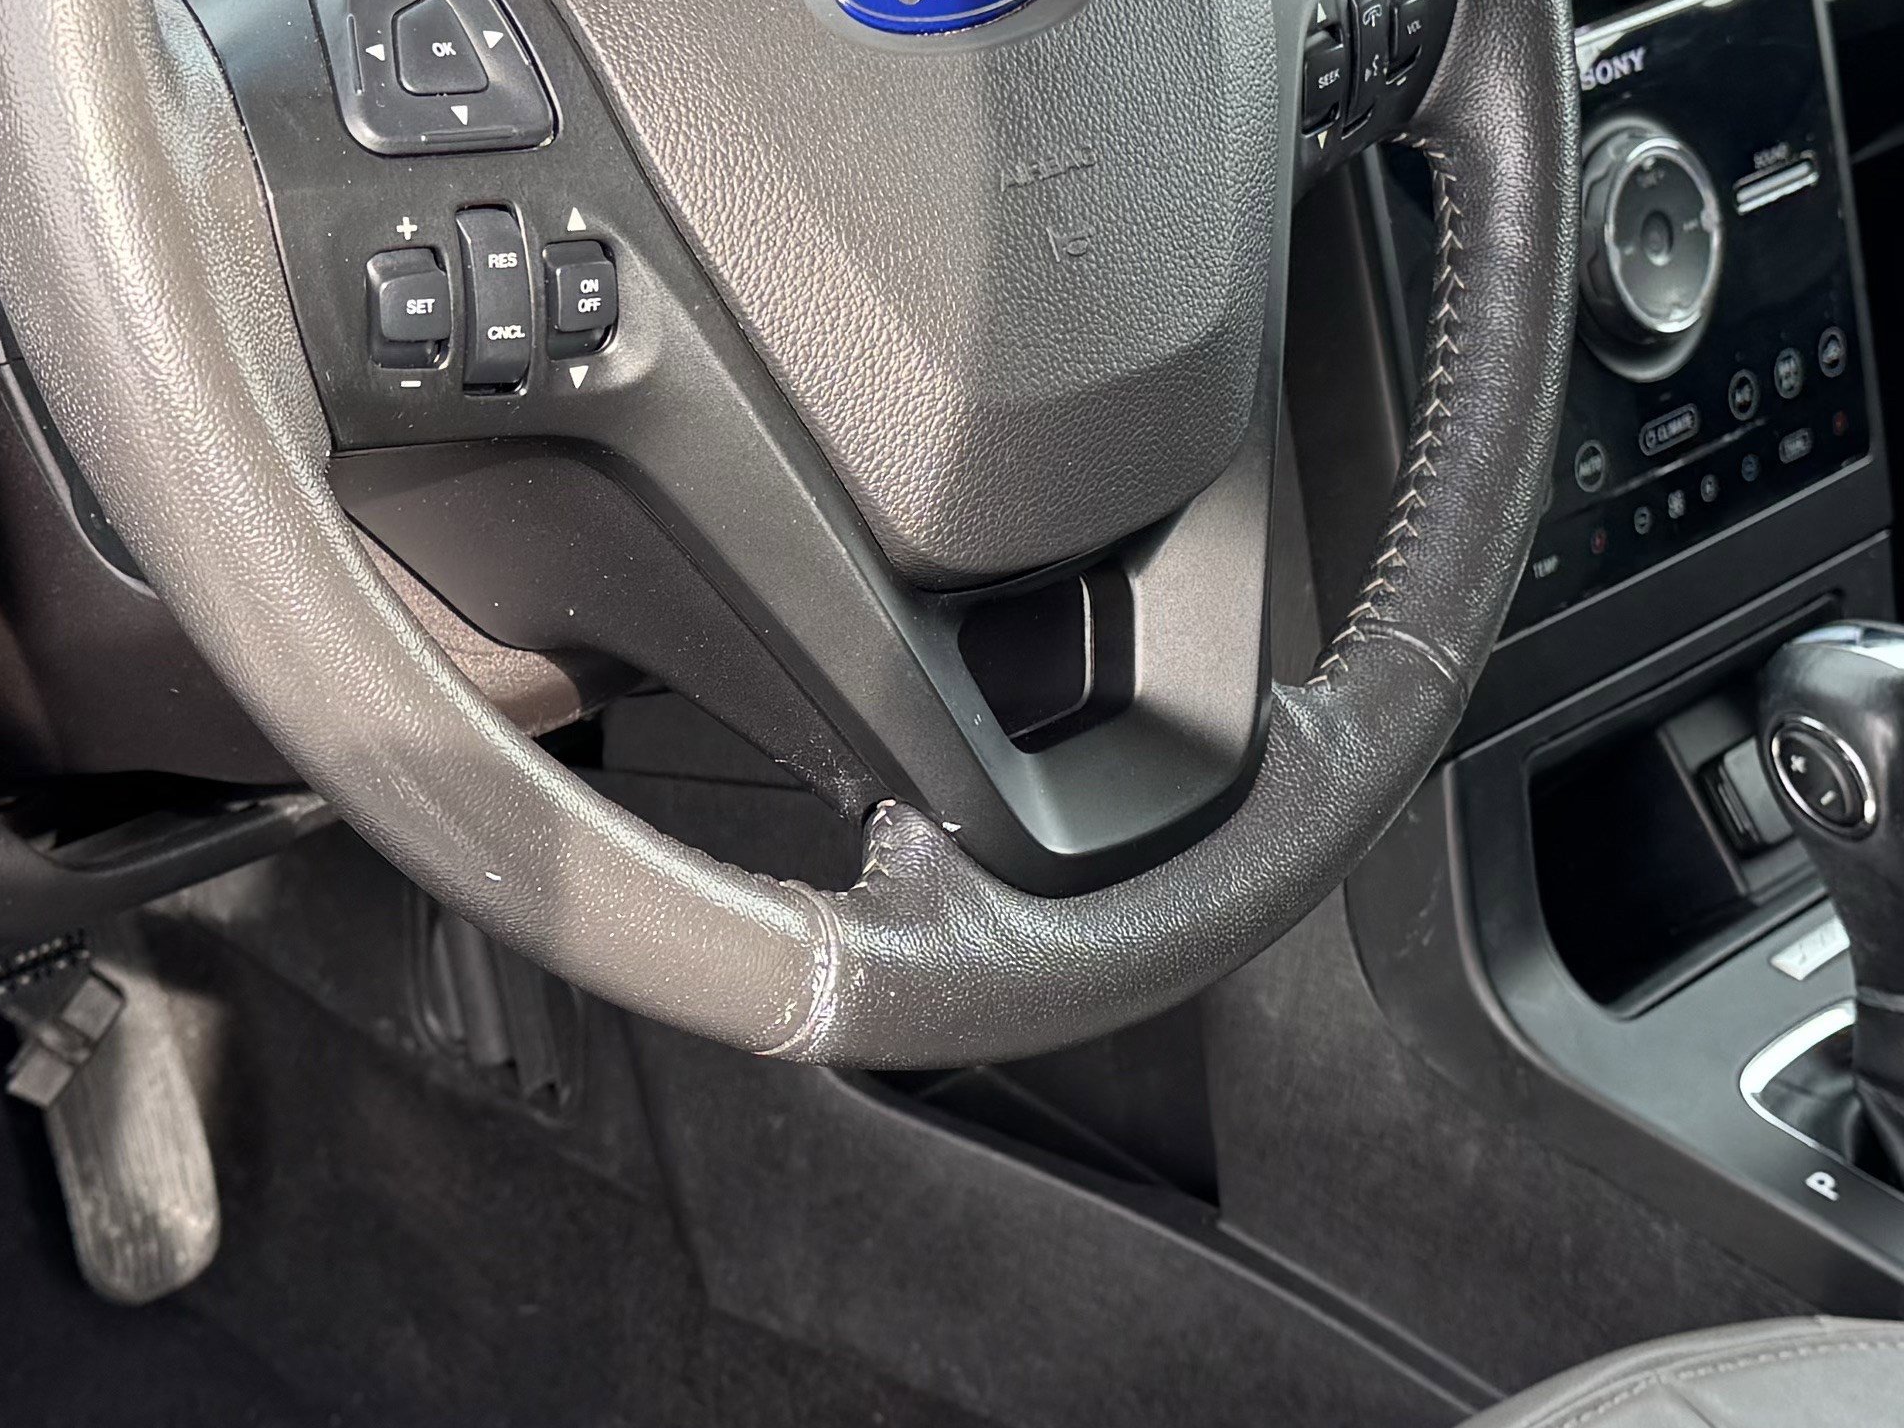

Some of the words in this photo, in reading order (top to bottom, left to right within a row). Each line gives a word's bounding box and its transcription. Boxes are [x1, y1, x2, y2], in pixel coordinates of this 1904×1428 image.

[432, 42, 456, 57] OK
[1580, 47, 1646, 91] SONY
[1318, 68, 1340, 89] SEEK
[488, 252, 518, 269] RES
[580, 279, 599, 294] ON
[406, 298, 435, 315] SET
[578, 298, 601, 313] OFF
[488, 325, 525, 341] CNCL
[1805, 1172, 1840, 1202] P
